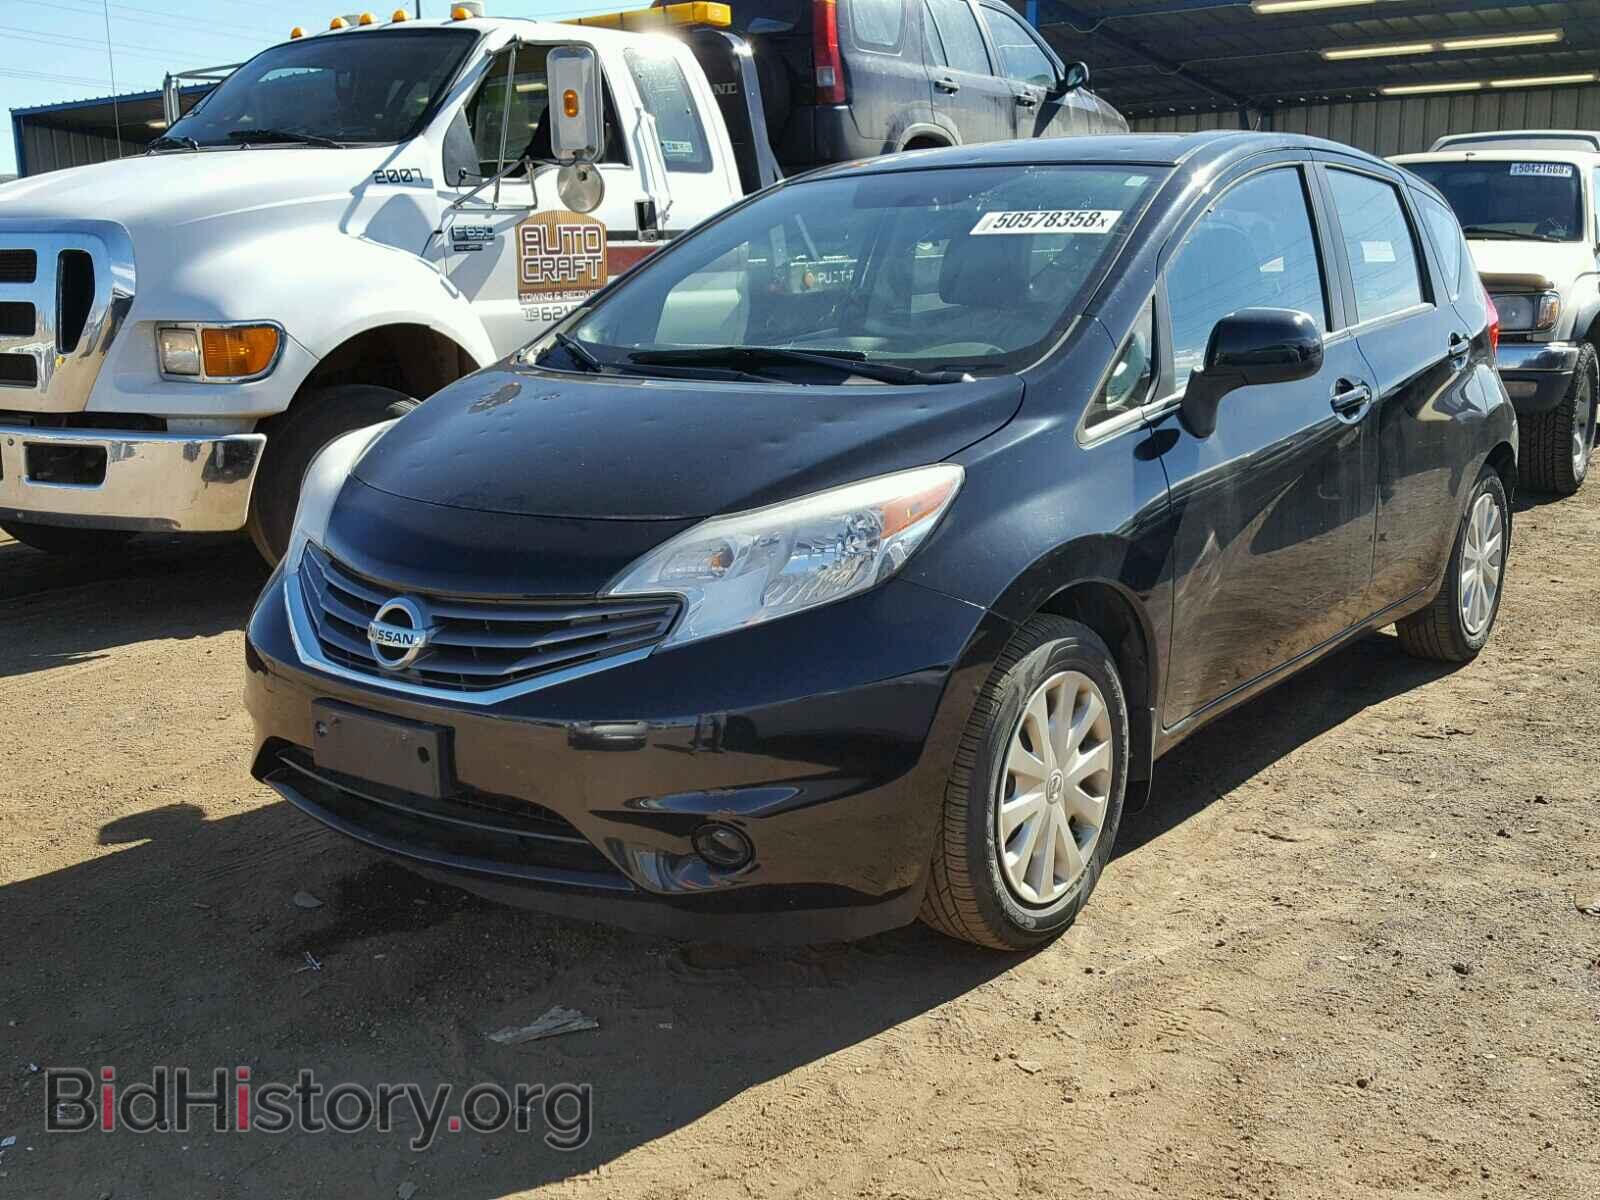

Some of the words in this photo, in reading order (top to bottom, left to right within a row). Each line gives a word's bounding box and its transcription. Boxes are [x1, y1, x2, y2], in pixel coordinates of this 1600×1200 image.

[373, 167, 424, 184] 2007
[520, 224, 604, 256] AUTO
[522, 255, 604, 283] CRAFT
[520, 291, 552, 302] TOWING
[368, 625, 414, 644] NISSAN
